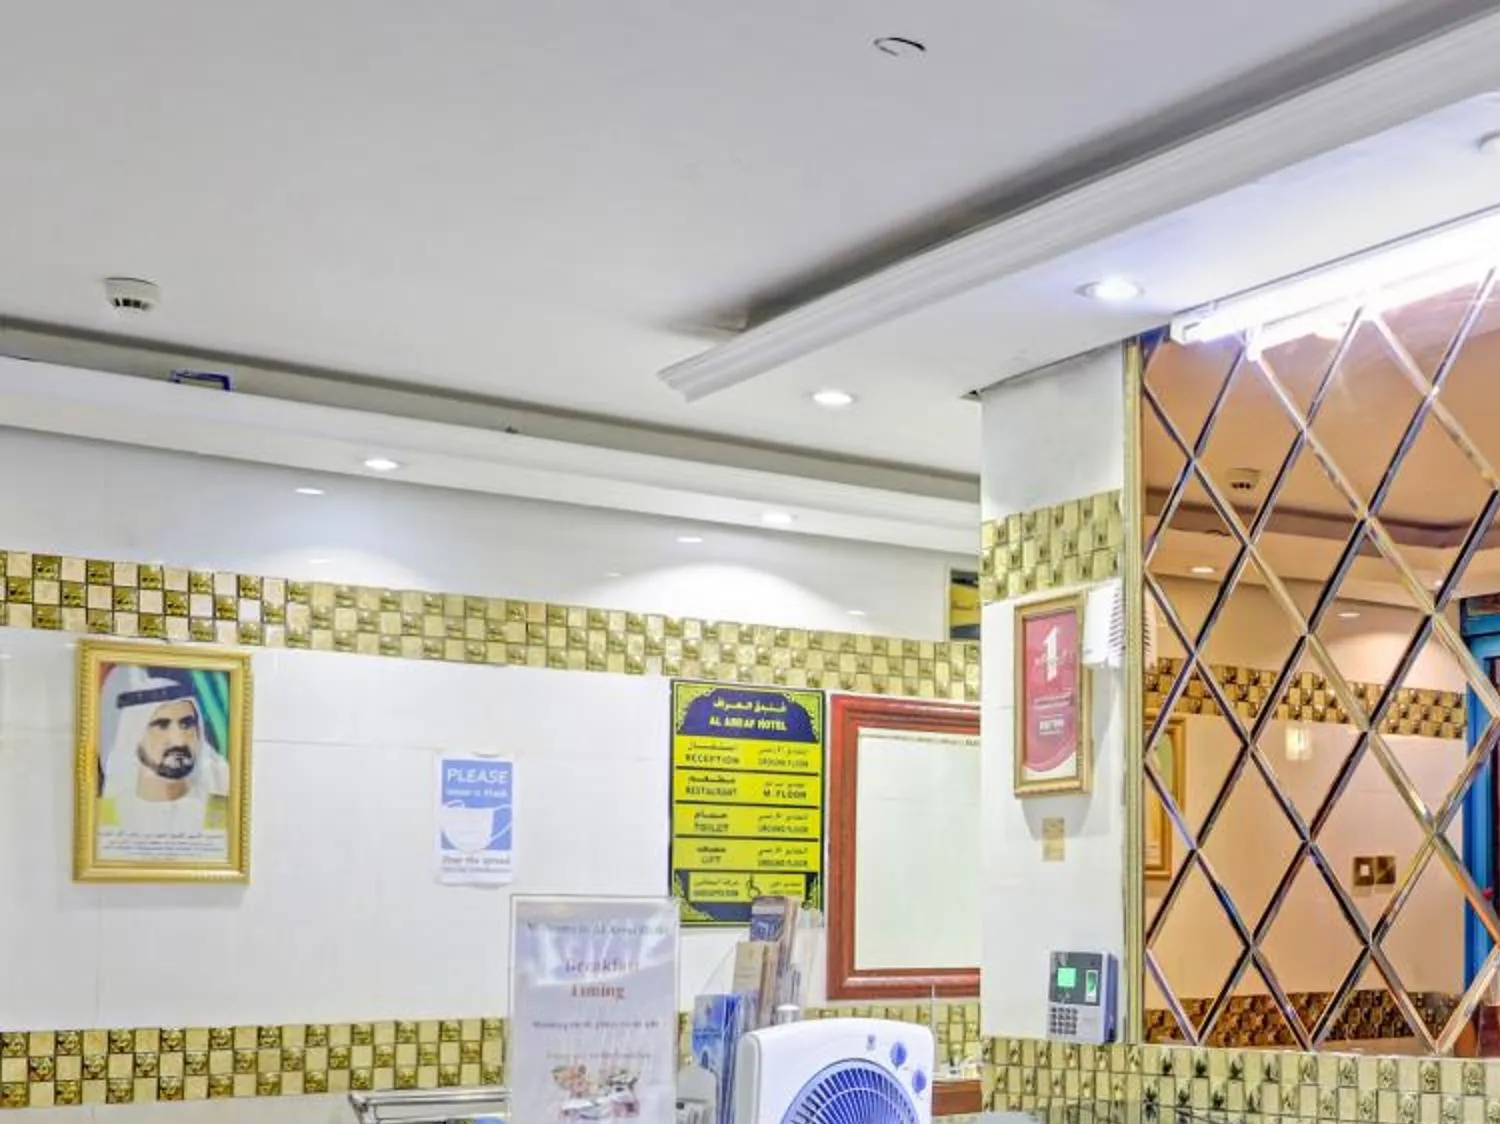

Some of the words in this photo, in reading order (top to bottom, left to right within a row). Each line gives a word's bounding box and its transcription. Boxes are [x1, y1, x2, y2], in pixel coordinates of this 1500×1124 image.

[757, 718, 788, 731] HOTEL
[685, 753, 740, 765] RECEPTION
[447, 768, 509, 784] PLEASE
[685, 787, 737, 797] RESTAURANT
[776, 790, 807, 799] FLOOR
[694, 822, 729, 832] TOILET
[570, 984, 626, 1001] Timing
